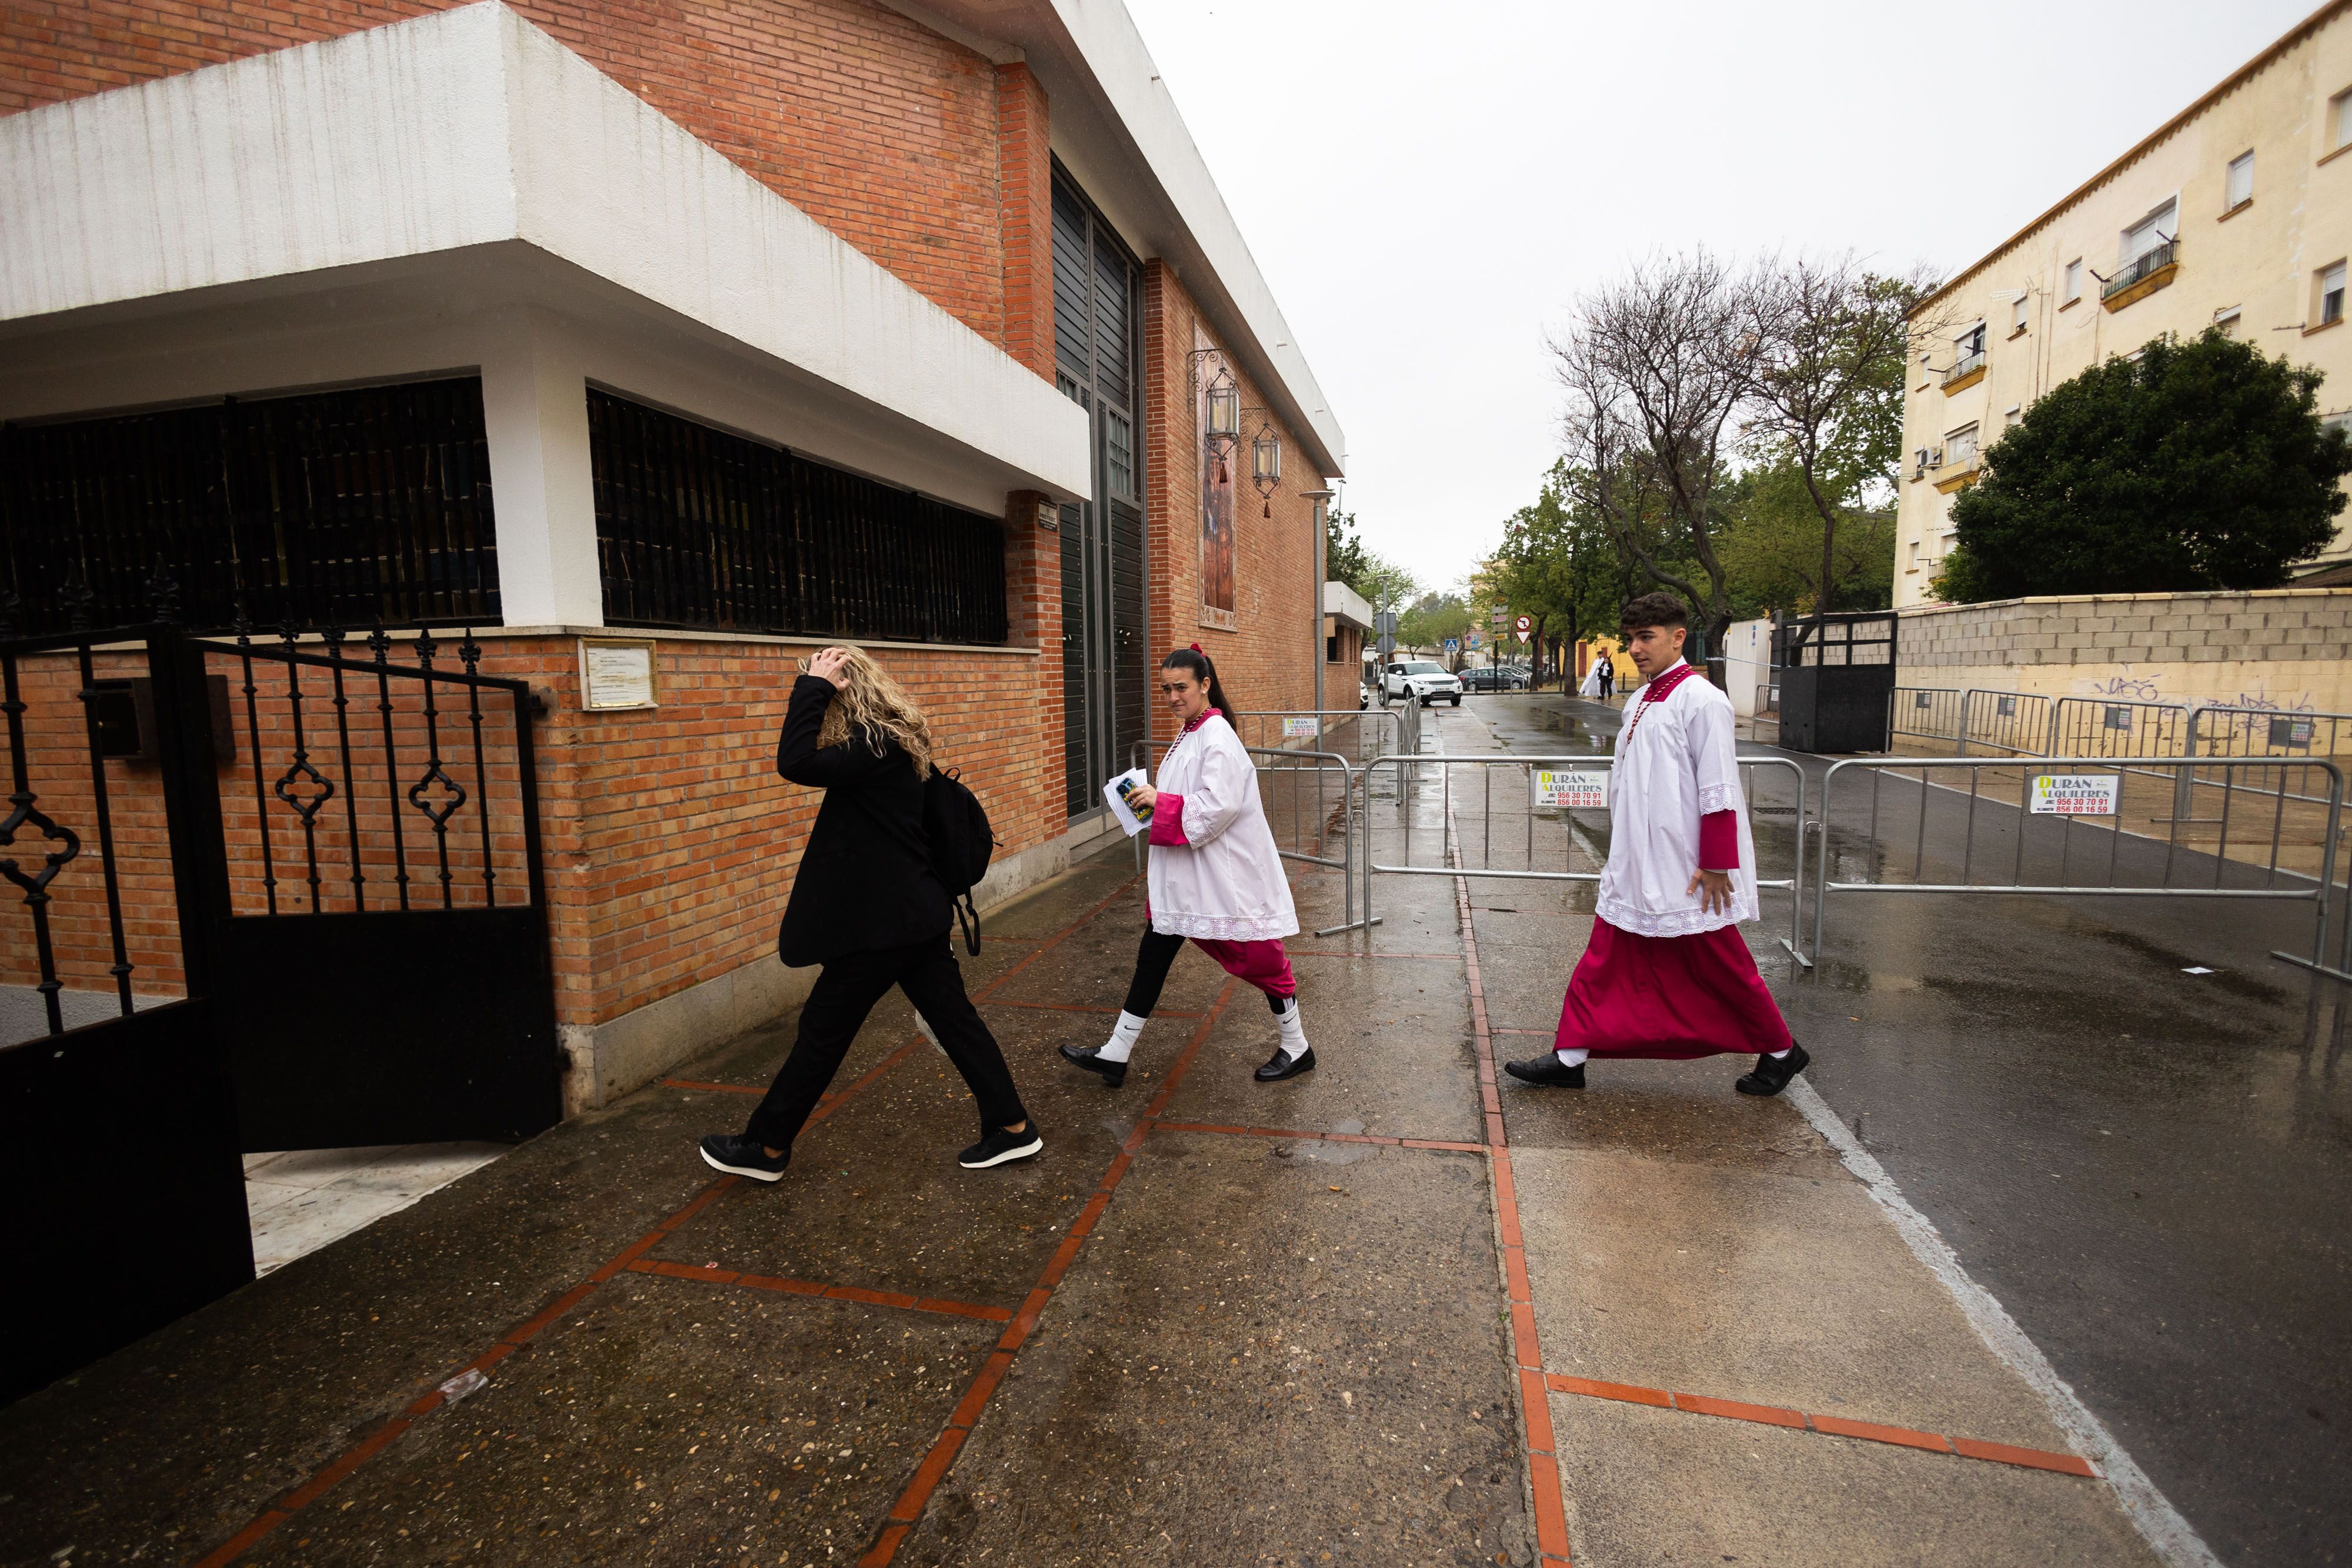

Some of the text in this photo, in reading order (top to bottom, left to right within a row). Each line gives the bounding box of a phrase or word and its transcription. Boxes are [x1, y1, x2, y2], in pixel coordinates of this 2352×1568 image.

[1541, 772, 1586, 783] DURÁN
[2039, 776, 2092, 788] DURÁN
[1542, 784, 1602, 792] ALQUILERES
[2039, 789, 2109, 798] ALQUILERES
